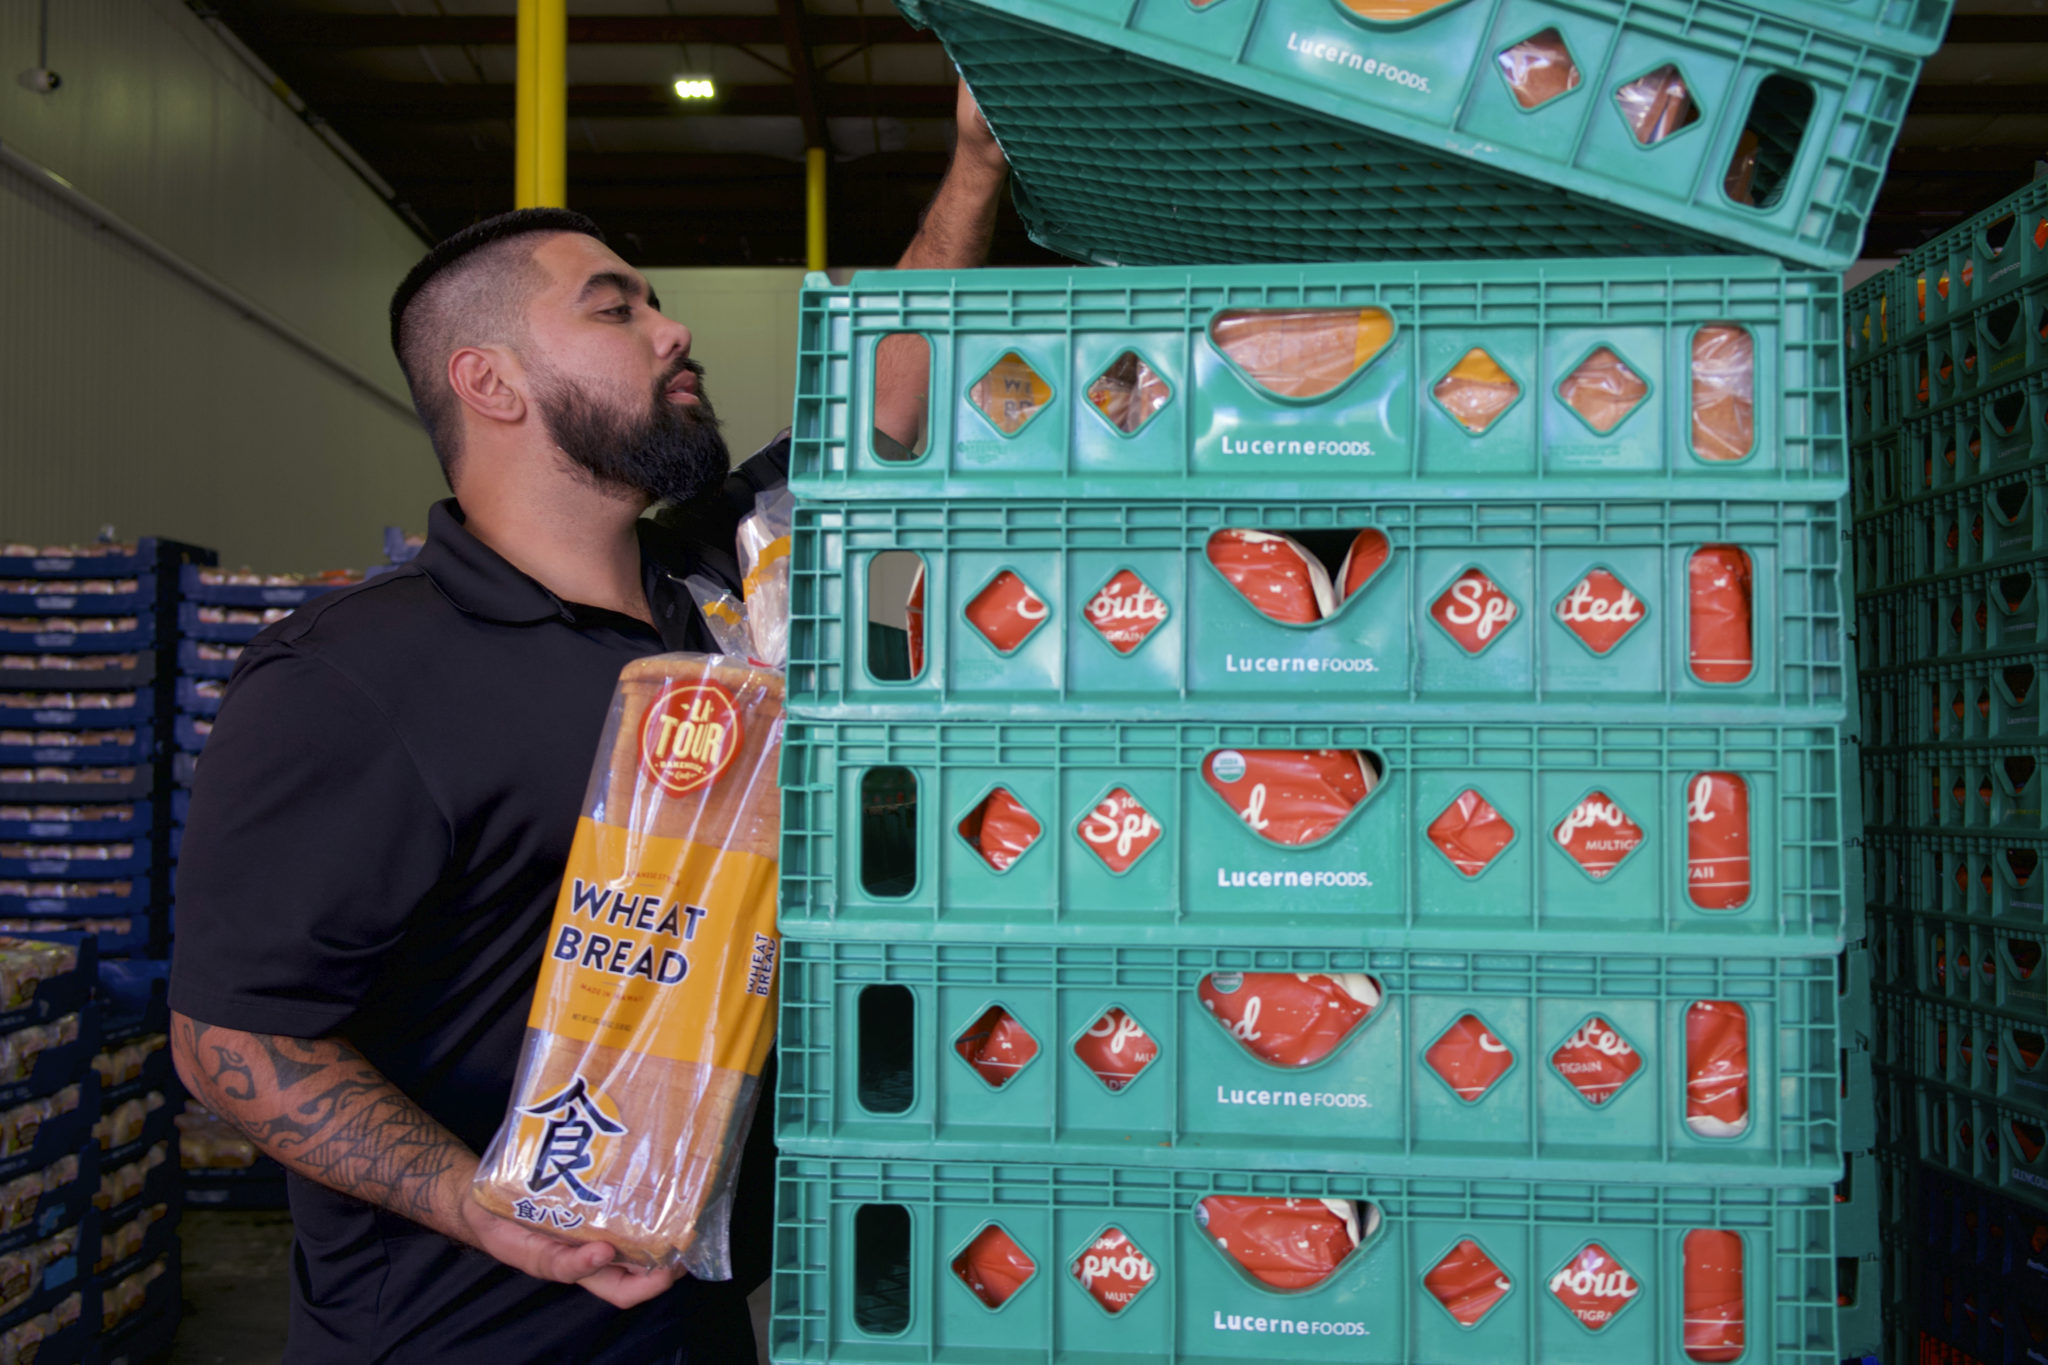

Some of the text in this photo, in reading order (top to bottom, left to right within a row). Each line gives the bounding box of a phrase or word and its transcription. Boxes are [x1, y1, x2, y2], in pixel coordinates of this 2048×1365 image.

[655, 714, 723, 765] TOUR
[690, 698, 712, 722] LA
[571, 877, 708, 942] WHEAT
[551, 924, 689, 987] BREAD
[746, 931, 770, 994] WHEAT
[514, 1073, 629, 1205] 食
[512, 1198, 586, 1230] 食パン
